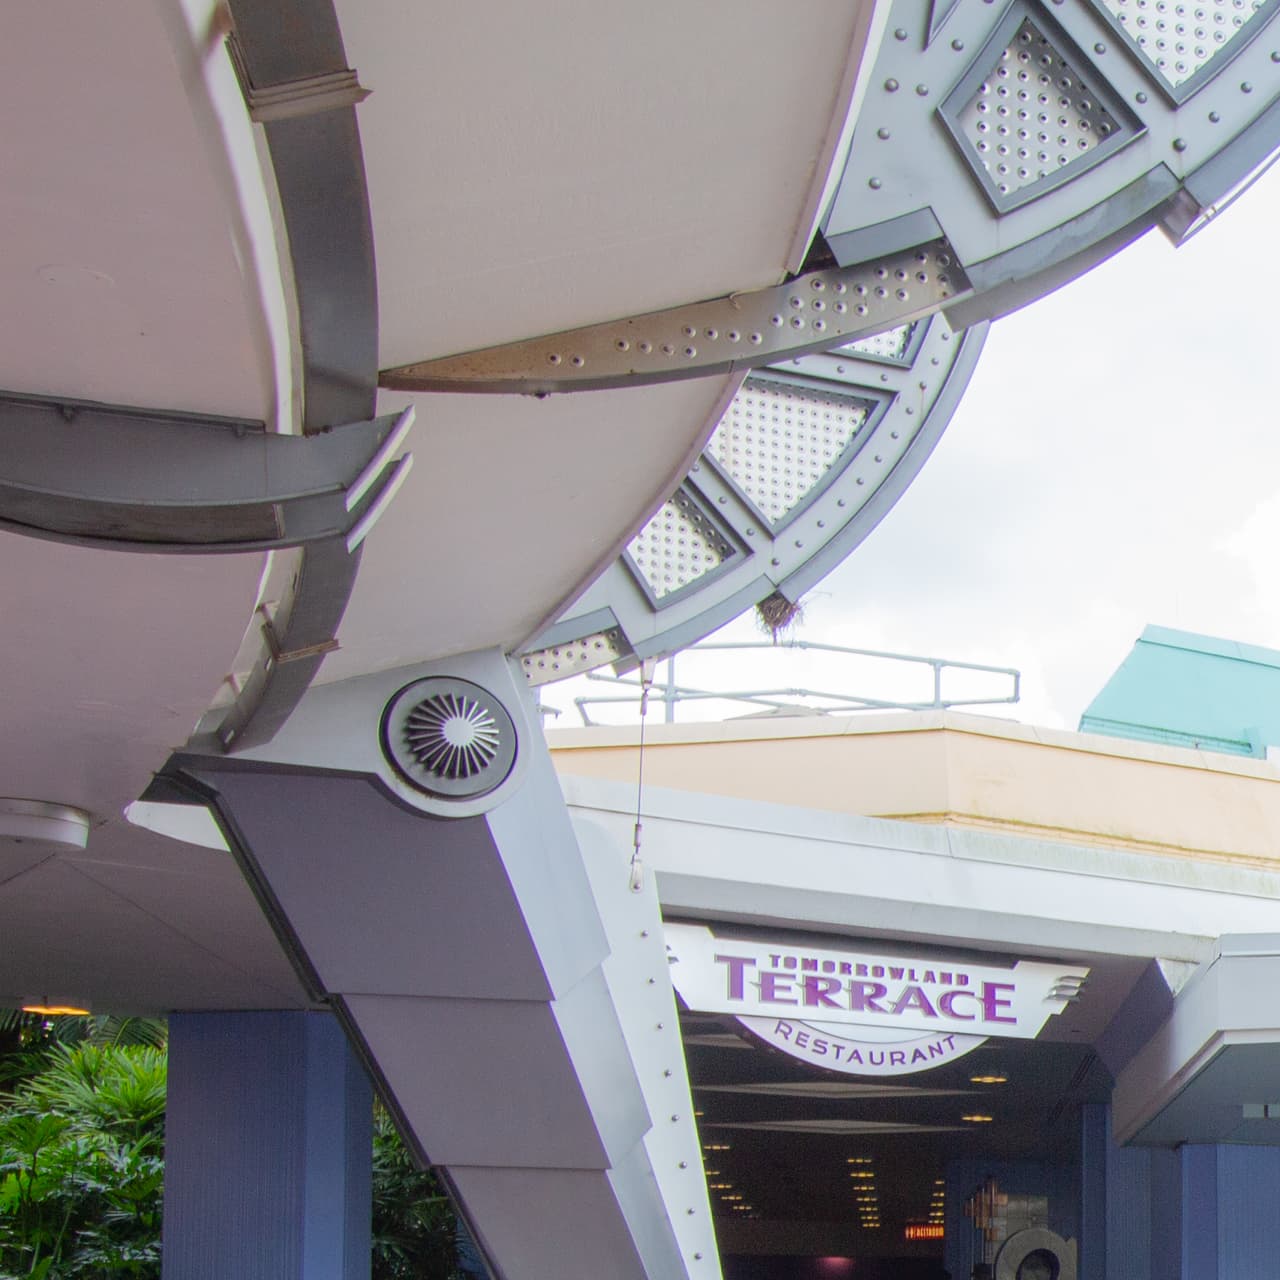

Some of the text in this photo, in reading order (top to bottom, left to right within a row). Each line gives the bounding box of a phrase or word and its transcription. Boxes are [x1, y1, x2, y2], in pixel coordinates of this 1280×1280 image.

[713, 953, 1018, 1025] TERRACE
[768, 954, 970, 987] TOMORROWLAND
[773, 1018, 957, 1067] RESTAURANT
